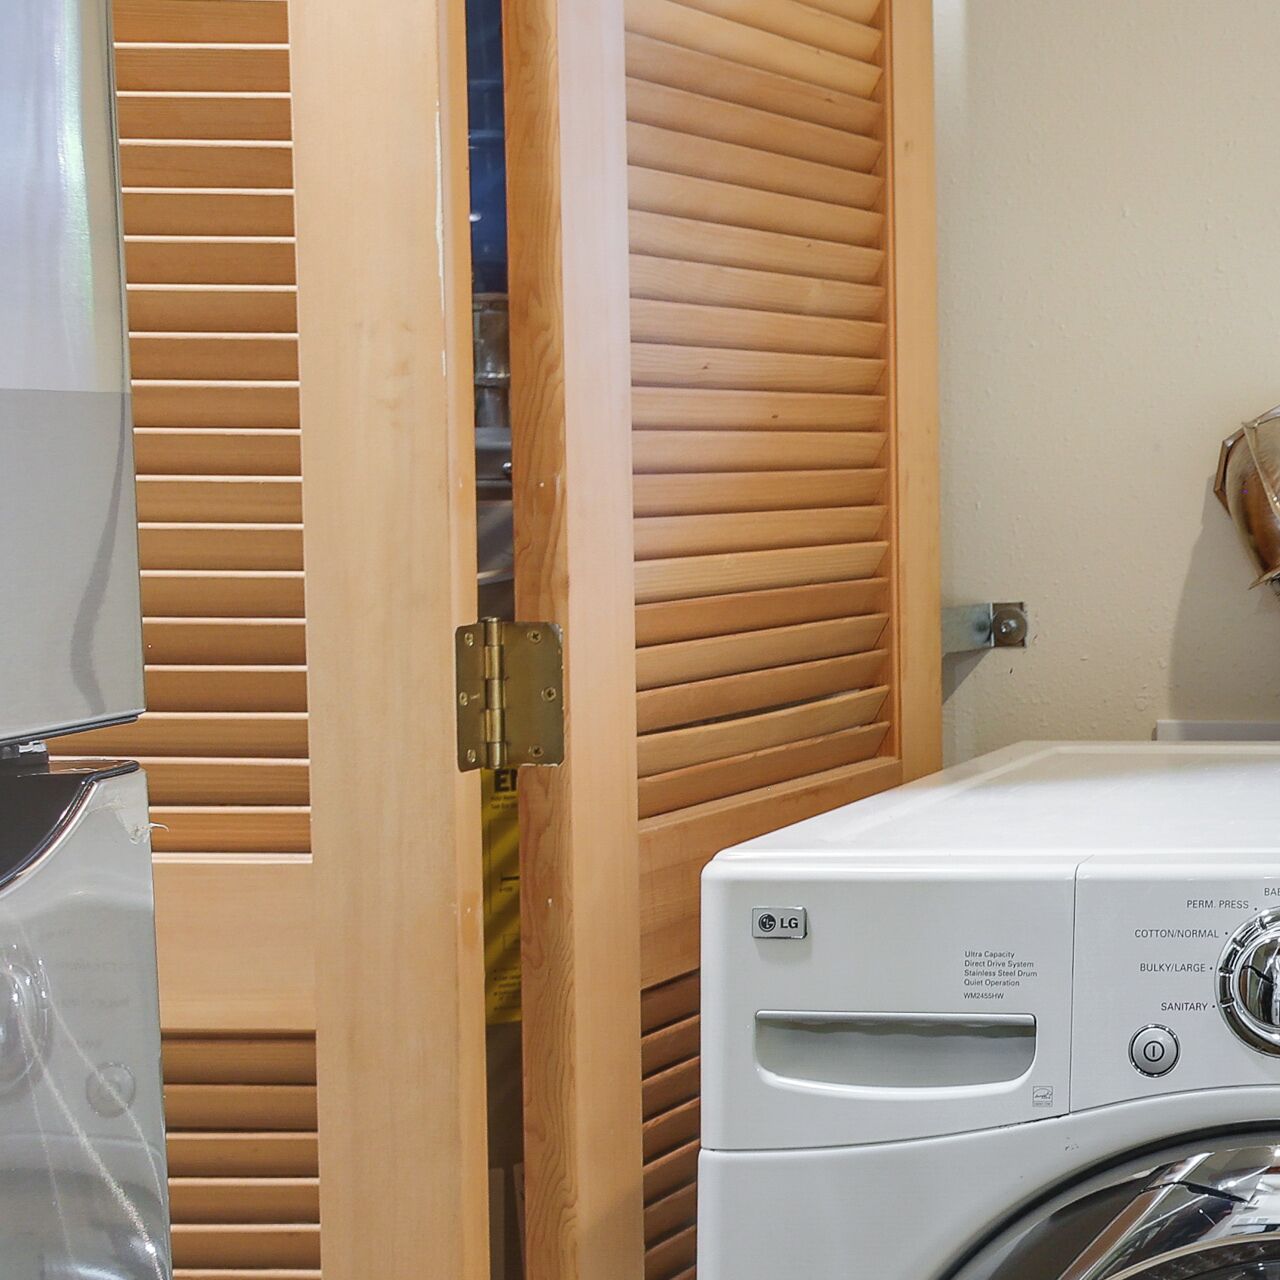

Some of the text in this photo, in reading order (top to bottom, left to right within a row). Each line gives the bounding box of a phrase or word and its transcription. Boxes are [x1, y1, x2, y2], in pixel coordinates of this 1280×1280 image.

[1186, 900, 1249, 909] PERM. PRESS
[780, 917, 799, 928] LG
[1134, 929, 1219, 938] COTTON/NORMAL
[964, 950, 1015, 959] Ultra Capacity
[1007, 960, 1034, 968] System
[1139, 963, 1206, 973] BULKY/LARGE
[964, 969, 996, 977] Stainless
[997, 969, 1015, 977] Steel
[964, 978, 1020, 987] Quiet Operation
[1161, 1002, 1209, 1011] SANITARY
